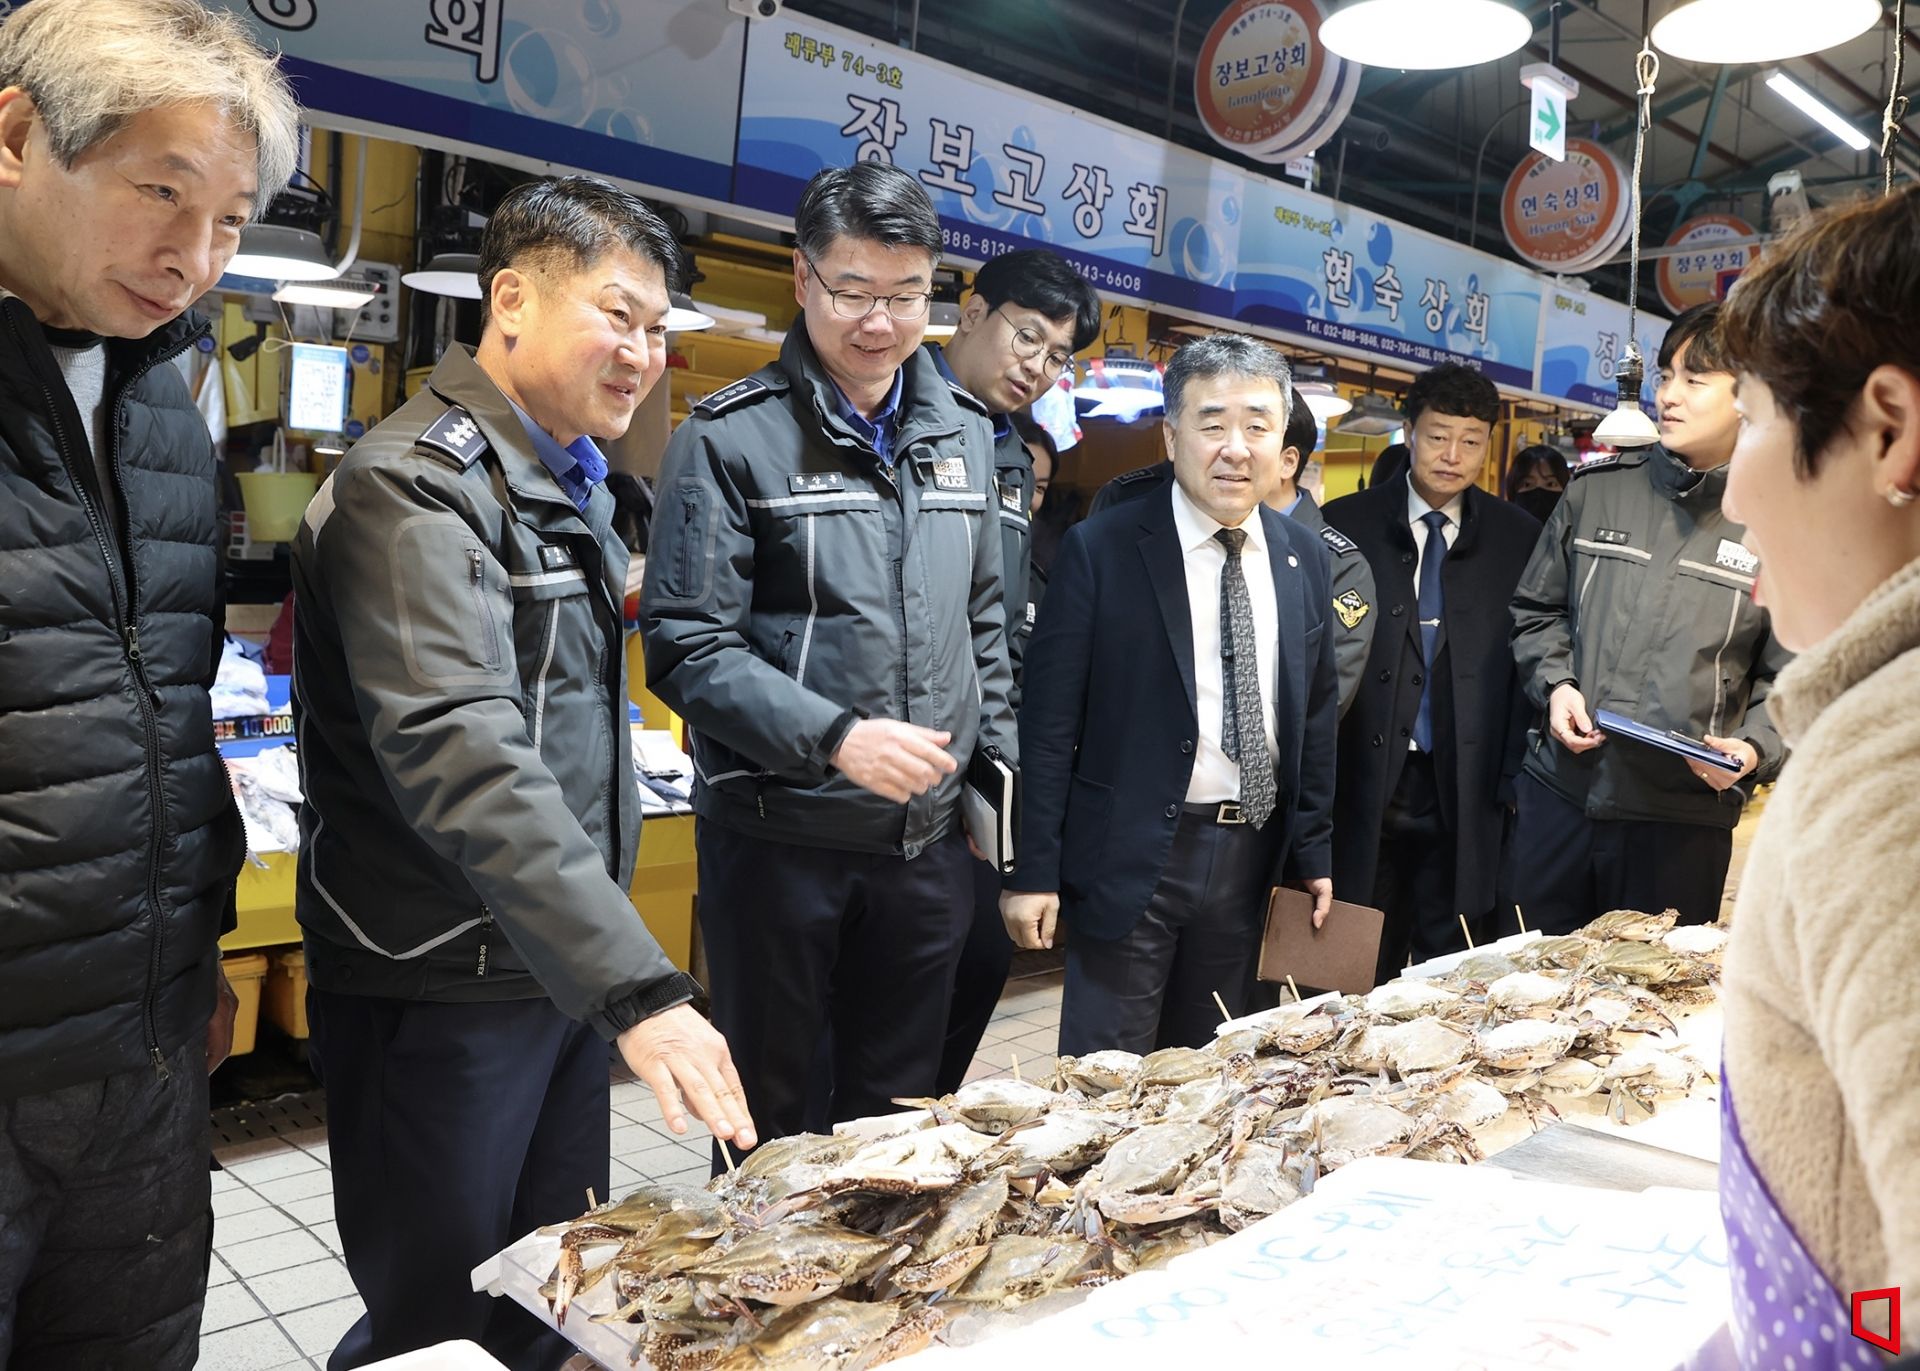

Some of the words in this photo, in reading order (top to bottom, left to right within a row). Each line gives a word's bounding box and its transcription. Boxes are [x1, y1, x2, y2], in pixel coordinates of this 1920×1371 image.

[785, 32, 835, 68] 패류부
[842, 50, 903, 89] 74-3호
[1216, 42, 1306, 87] 장보고상회
[841, 94, 1168, 257] 장보고상회
[1521, 182, 1600, 218] 현숙상회
[1677, 251, 1744, 274] 정우상회
[1322, 247, 1490, 345] 현숙상회
[936, 475, 968, 488] POLICE
[1715, 554, 1754, 573] POLICE
